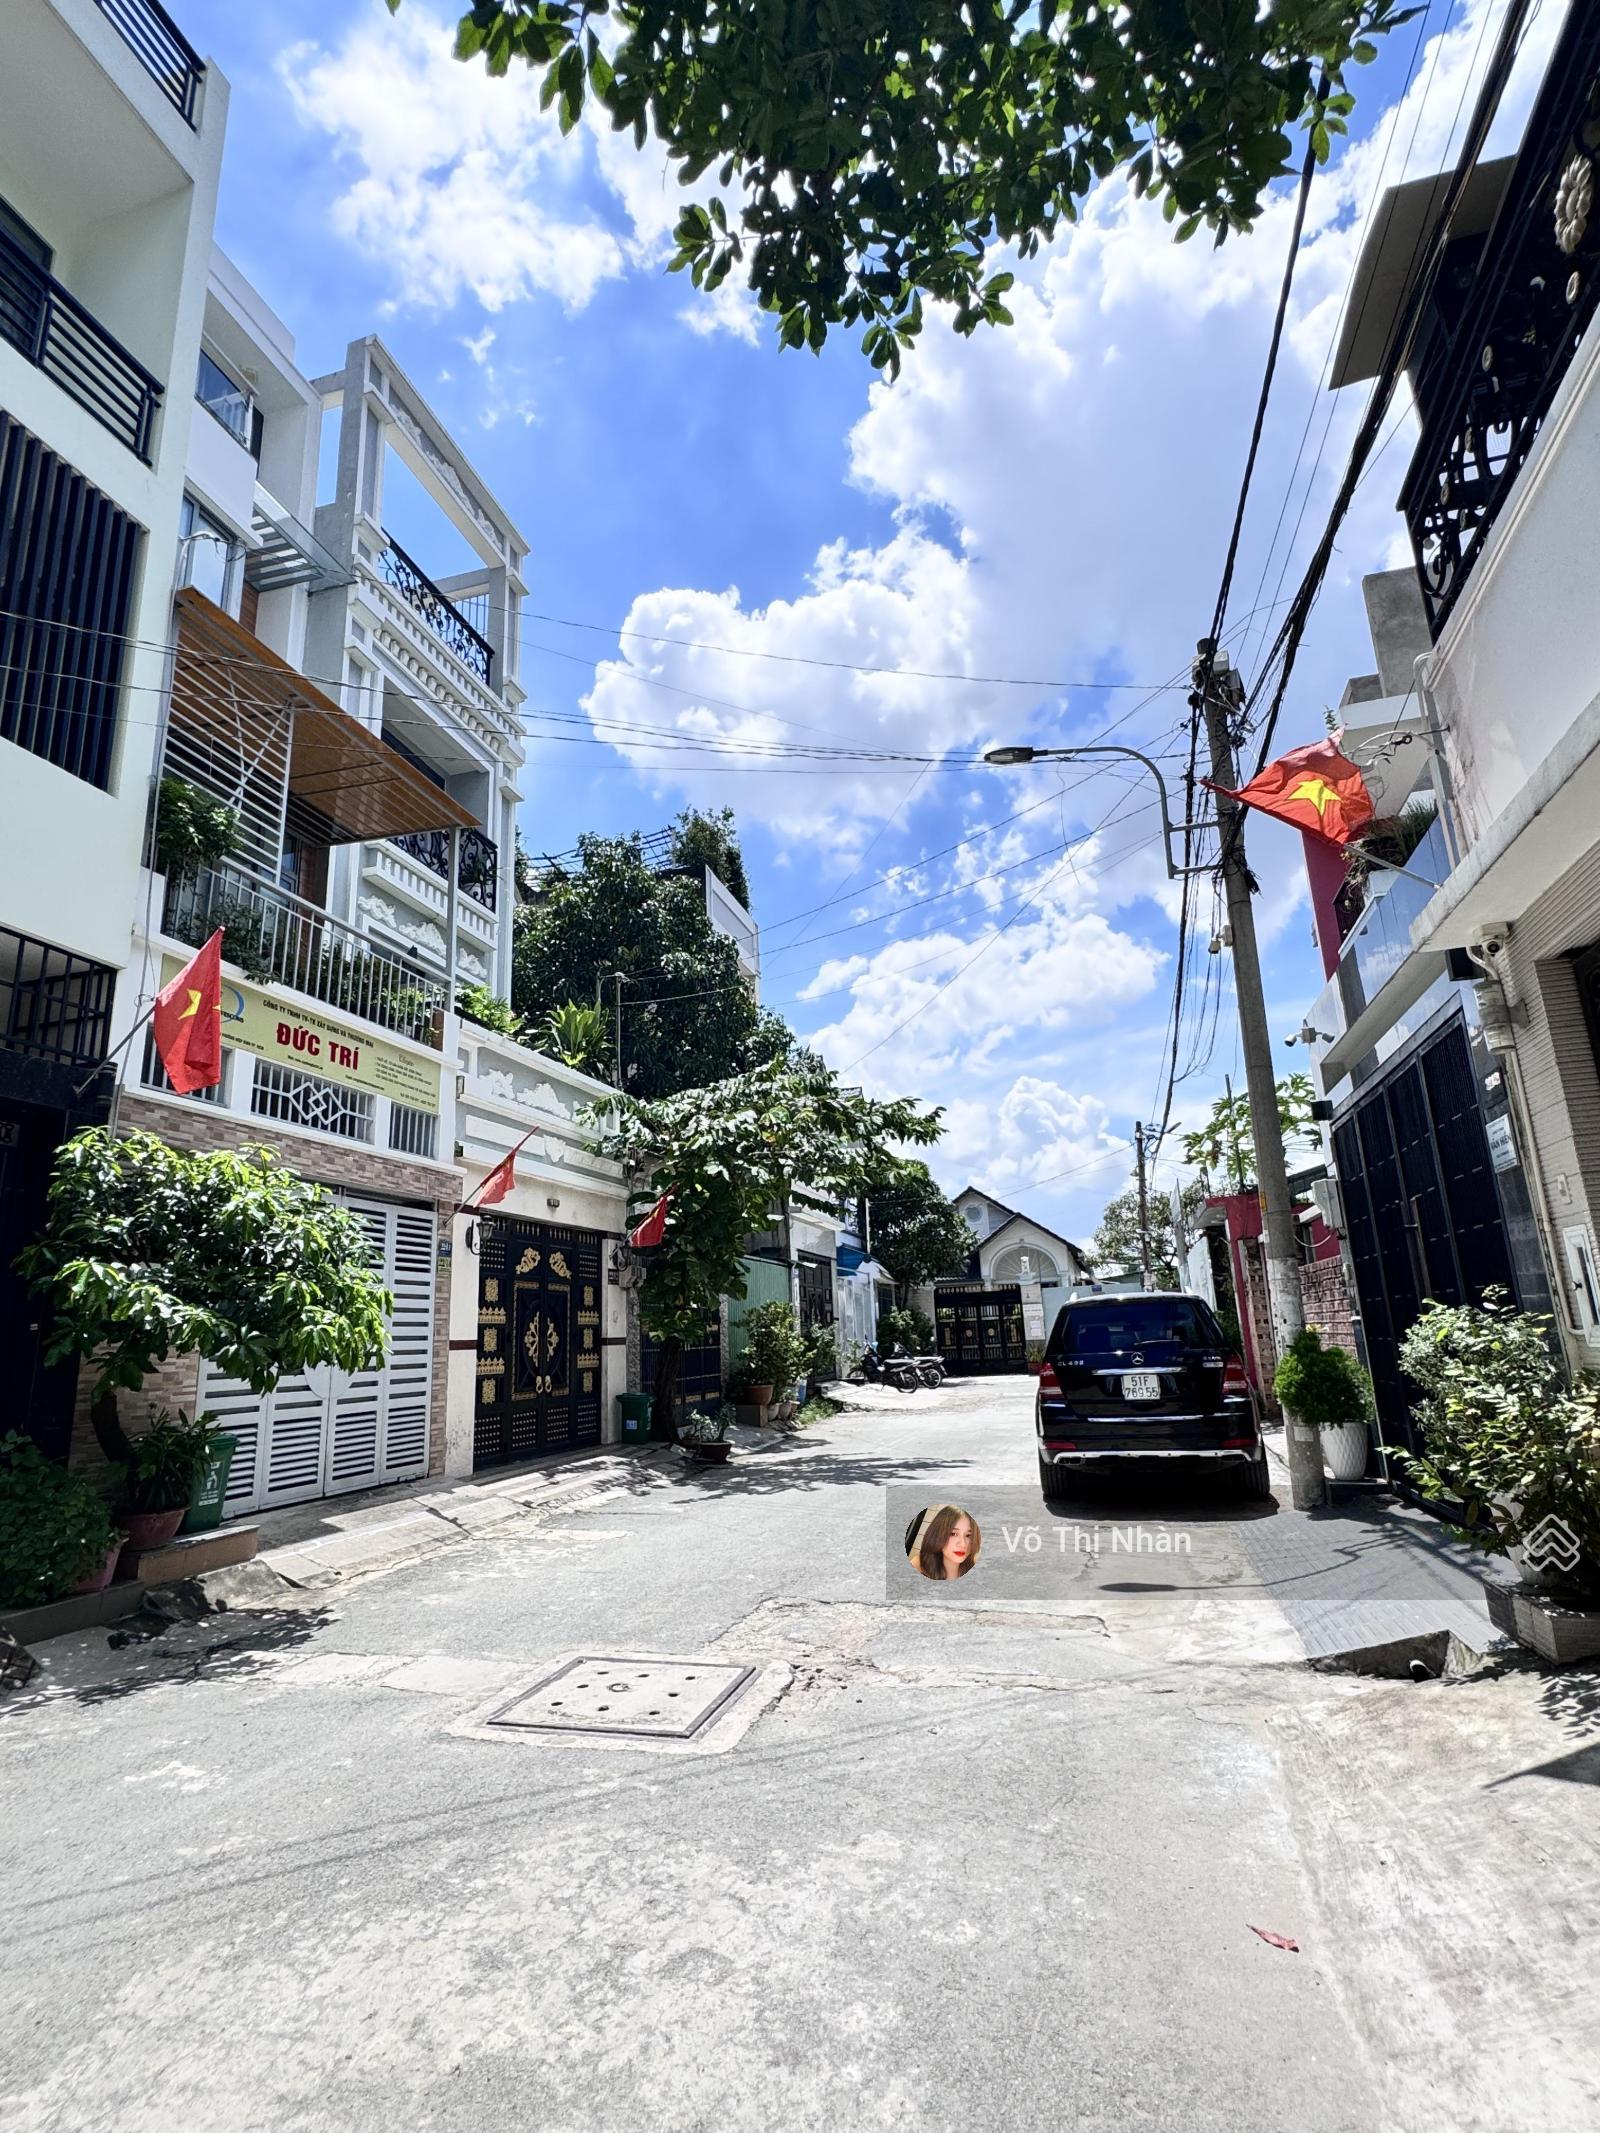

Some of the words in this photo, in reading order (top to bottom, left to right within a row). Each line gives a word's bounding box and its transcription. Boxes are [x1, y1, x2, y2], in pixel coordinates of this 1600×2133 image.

[276, 1022, 321, 1056] ĐỨC
[328, 1040, 360, 1071] TRÍ
[1131, 1376, 1149, 1386] 51F
